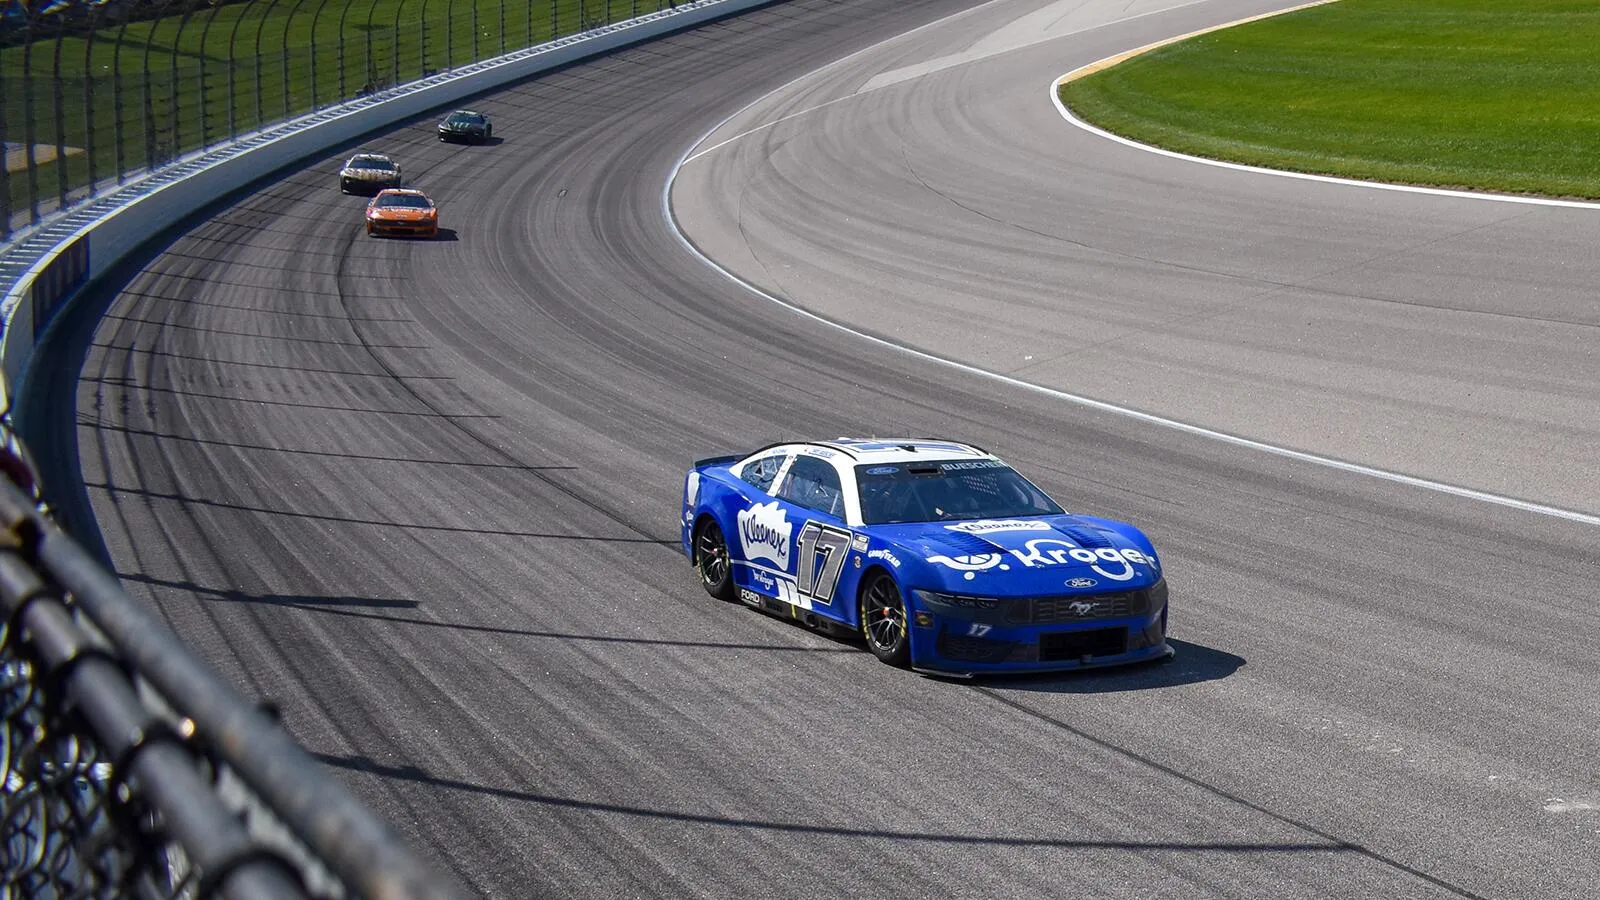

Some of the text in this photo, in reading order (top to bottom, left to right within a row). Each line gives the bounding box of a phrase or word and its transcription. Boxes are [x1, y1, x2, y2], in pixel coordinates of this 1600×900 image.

[743, 514, 786, 557] Kleenex
[797, 519, 852, 606] 17
[1009, 539, 1156, 581] Kroger
[741, 589, 760, 603] FORD
[1069, 578, 1094, 588] Ford
[967, 623, 993, 637] 17
